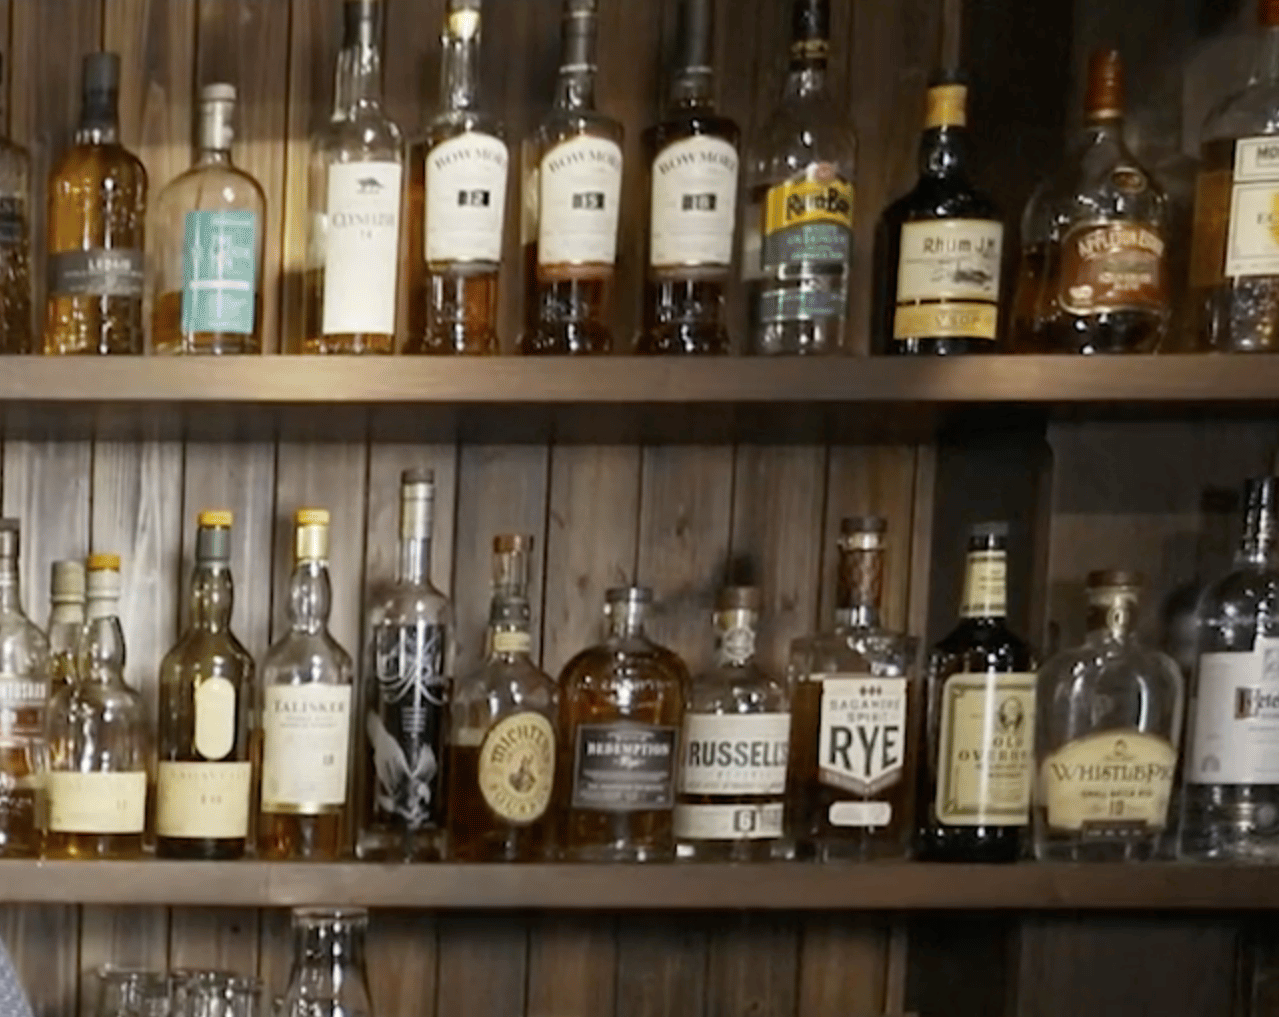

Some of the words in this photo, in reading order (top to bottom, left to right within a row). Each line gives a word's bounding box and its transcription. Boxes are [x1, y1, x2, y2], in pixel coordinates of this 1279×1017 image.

[923, 236, 972, 253] Rhum
[586, 742, 670, 756] REDEMPTION
[829, 725, 900, 778] RYE
